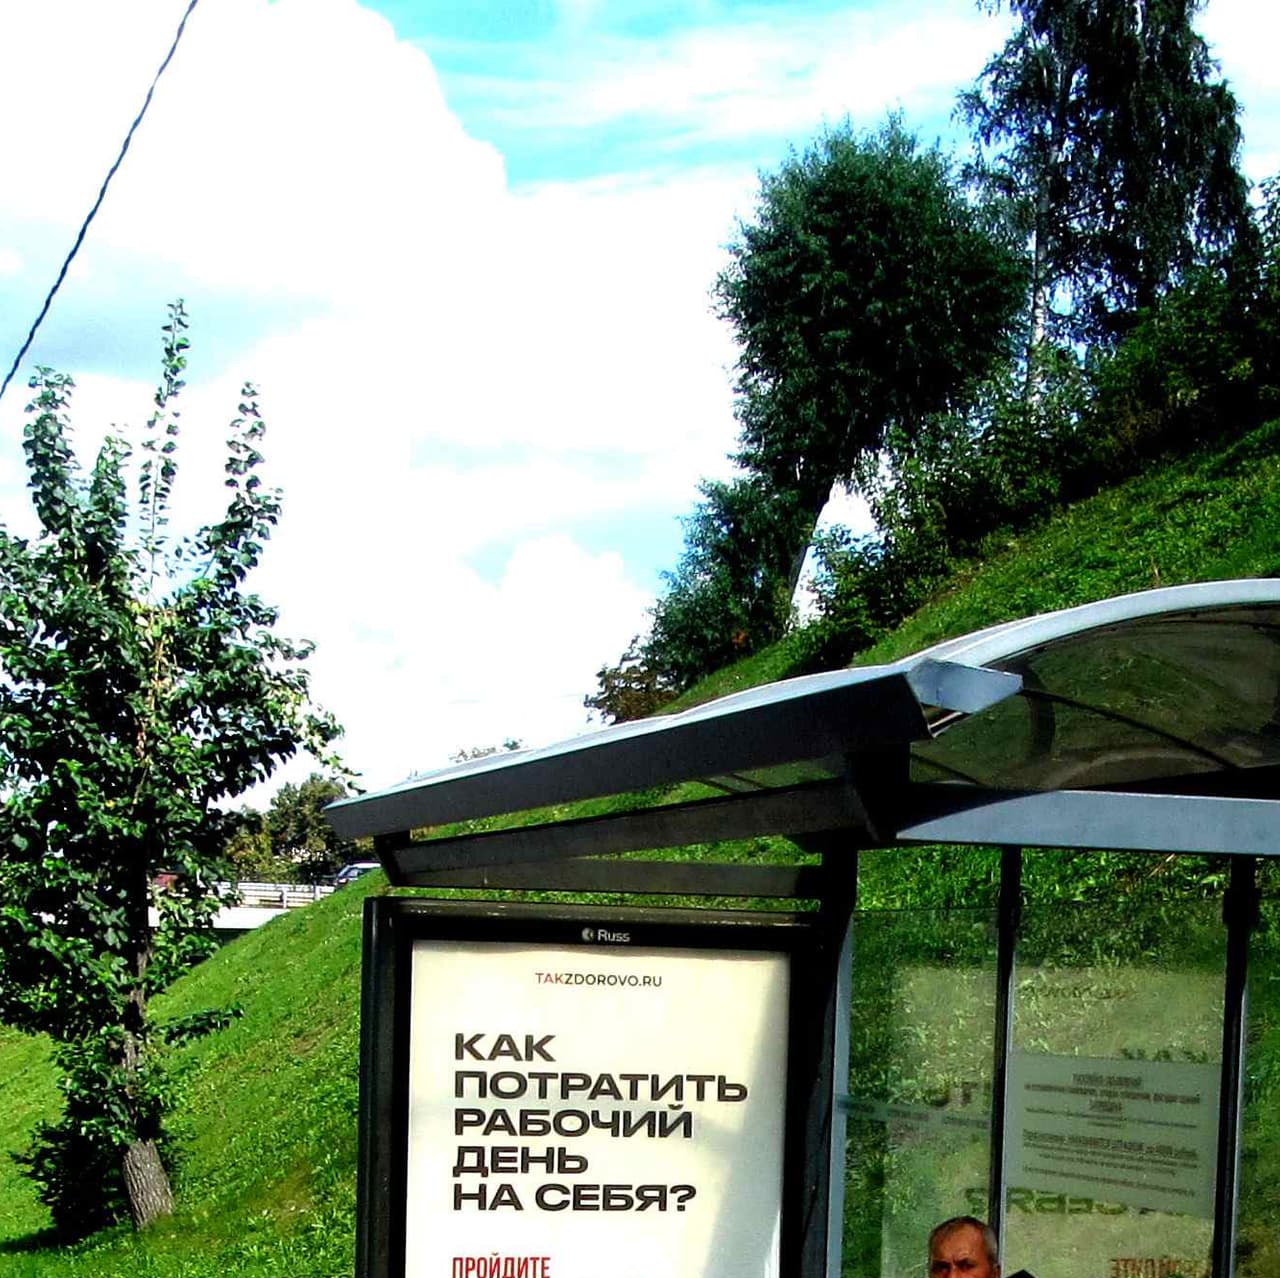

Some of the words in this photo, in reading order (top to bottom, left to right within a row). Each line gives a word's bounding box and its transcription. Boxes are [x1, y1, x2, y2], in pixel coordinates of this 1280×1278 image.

[597, 928, 631, 942] Russ
[534, 972, 663, 988] TAKZDOROVO.RU
[454, 1032, 557, 1062] КАК
[454, 1070, 749, 1103] ПОТРАТИТЬ
[454, 1103, 694, 1138] РАБОЧИЙ
[452, 1145, 590, 1178] ДЕНЬ
[453, 1183, 525, 1212] НА
[534, 1183, 698, 1212] СЕБЯ?
